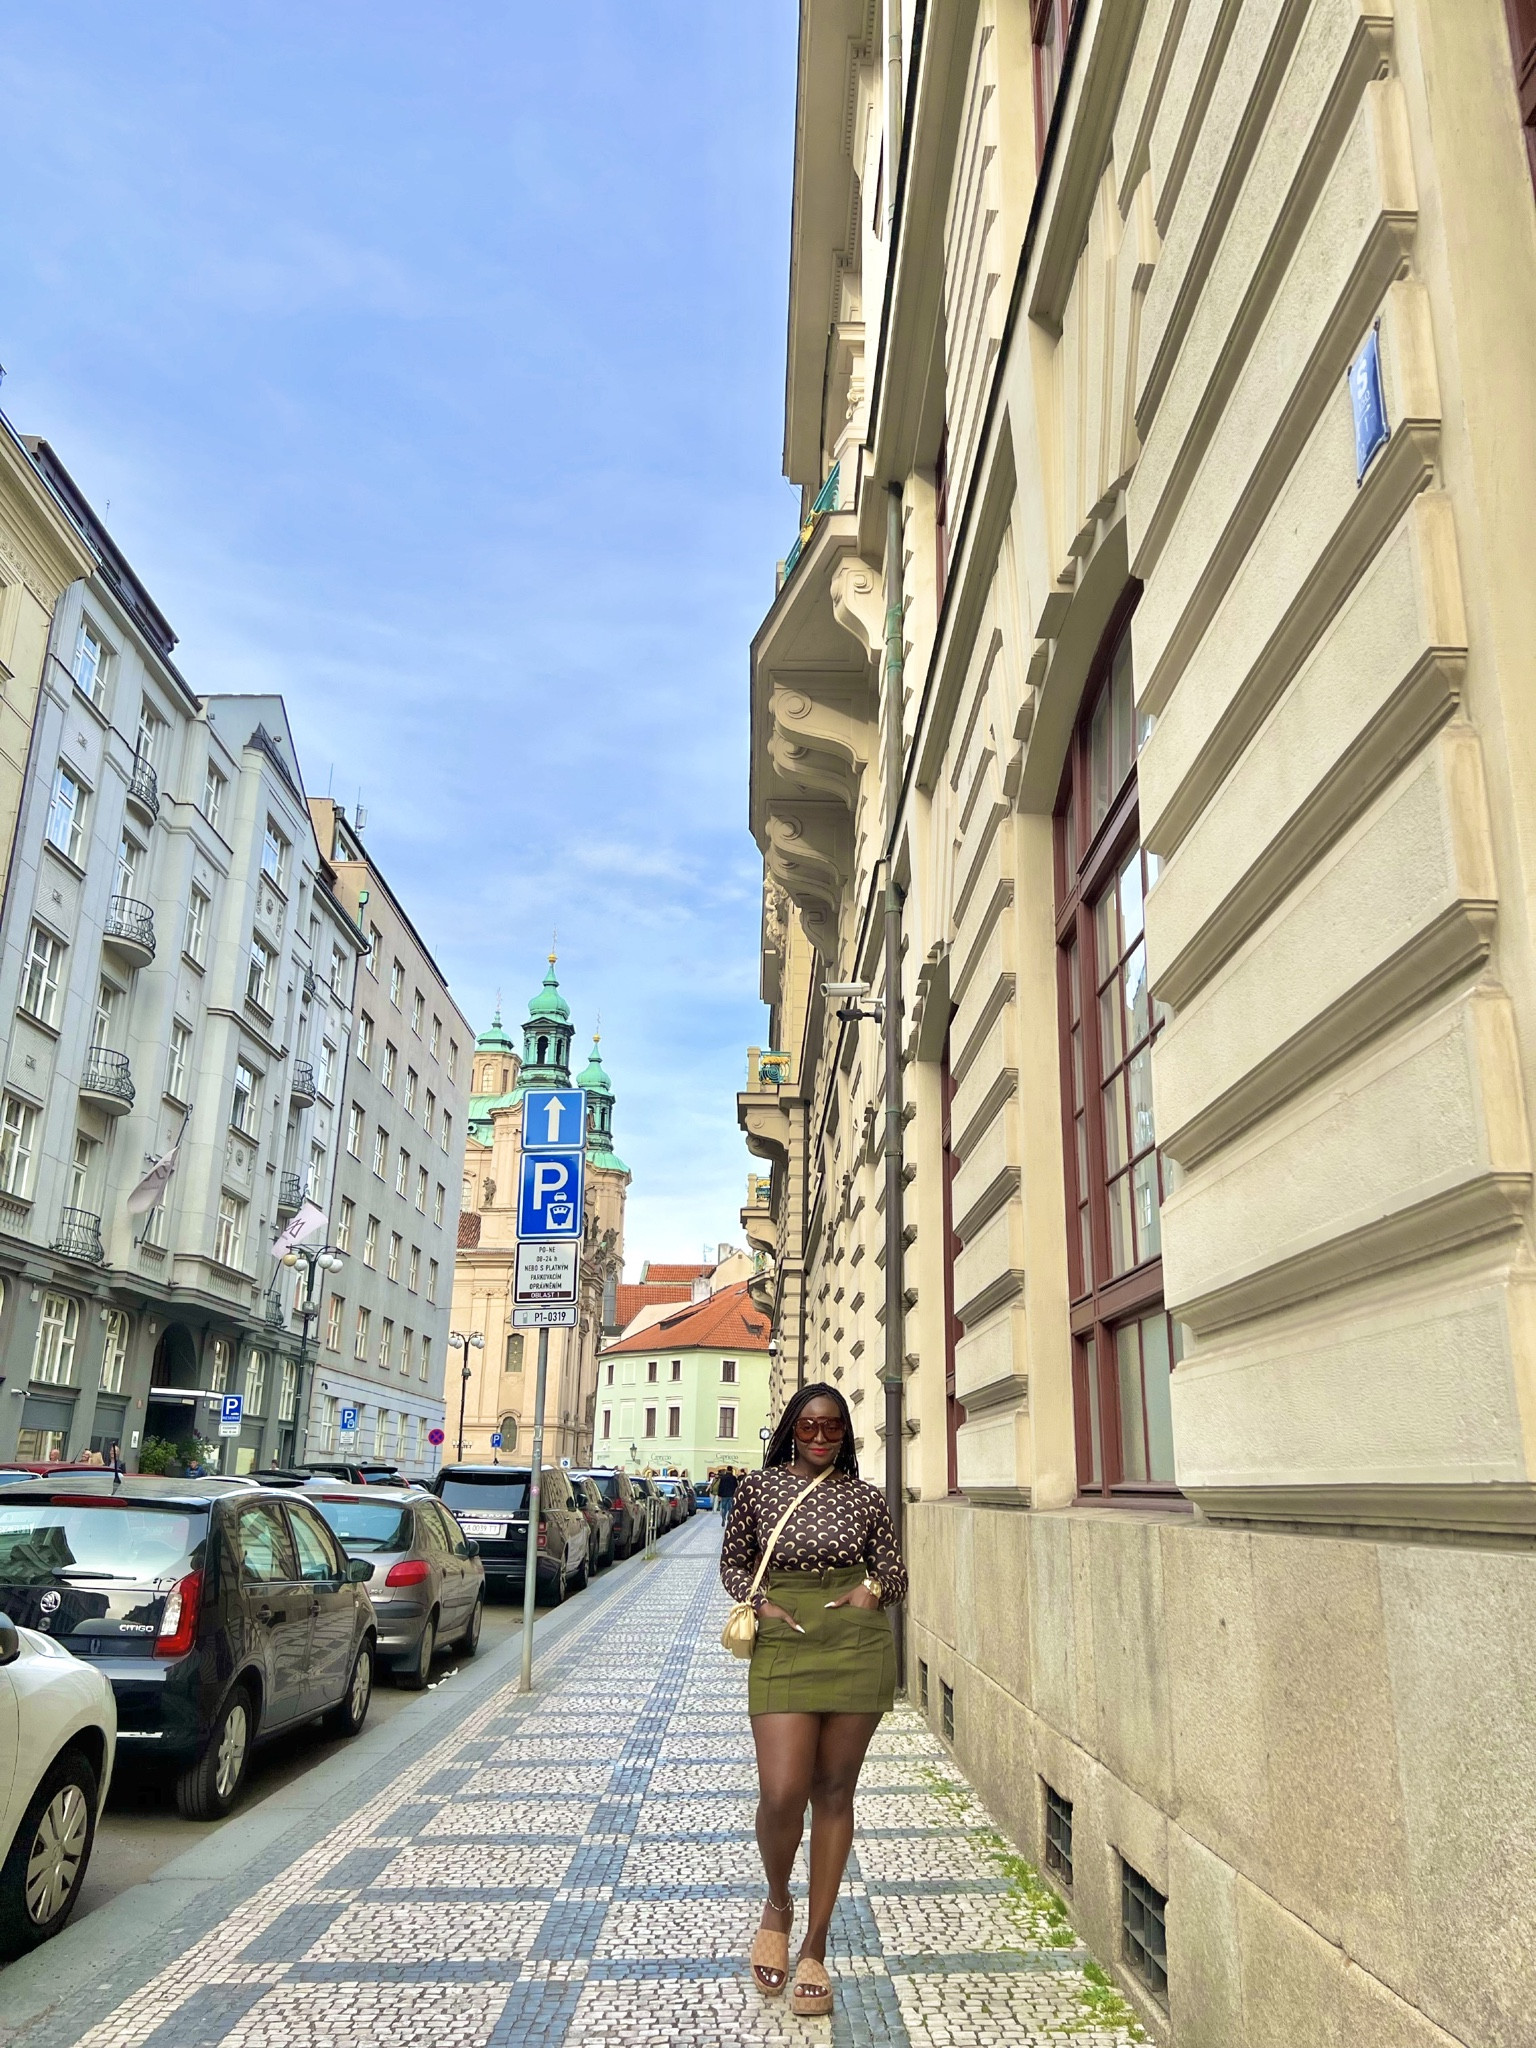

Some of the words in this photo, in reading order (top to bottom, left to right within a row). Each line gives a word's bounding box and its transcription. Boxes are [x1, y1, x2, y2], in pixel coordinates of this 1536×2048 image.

[533, 1162, 569, 1210] P
[545, 1263, 569, 1271] PLATNÝM
[530, 1272, 562, 1280] PARKOVACÍM
[529, 1281, 562, 1290] OPRÁVNĚNÍM
[534, 1311, 567, 1322] P1-0319
[225, 1398, 239, 1415] P
[344, 1410, 355, 1424] P
[493, 1434, 500, 1444] P
[119, 1624, 154, 1633] CITIGO
